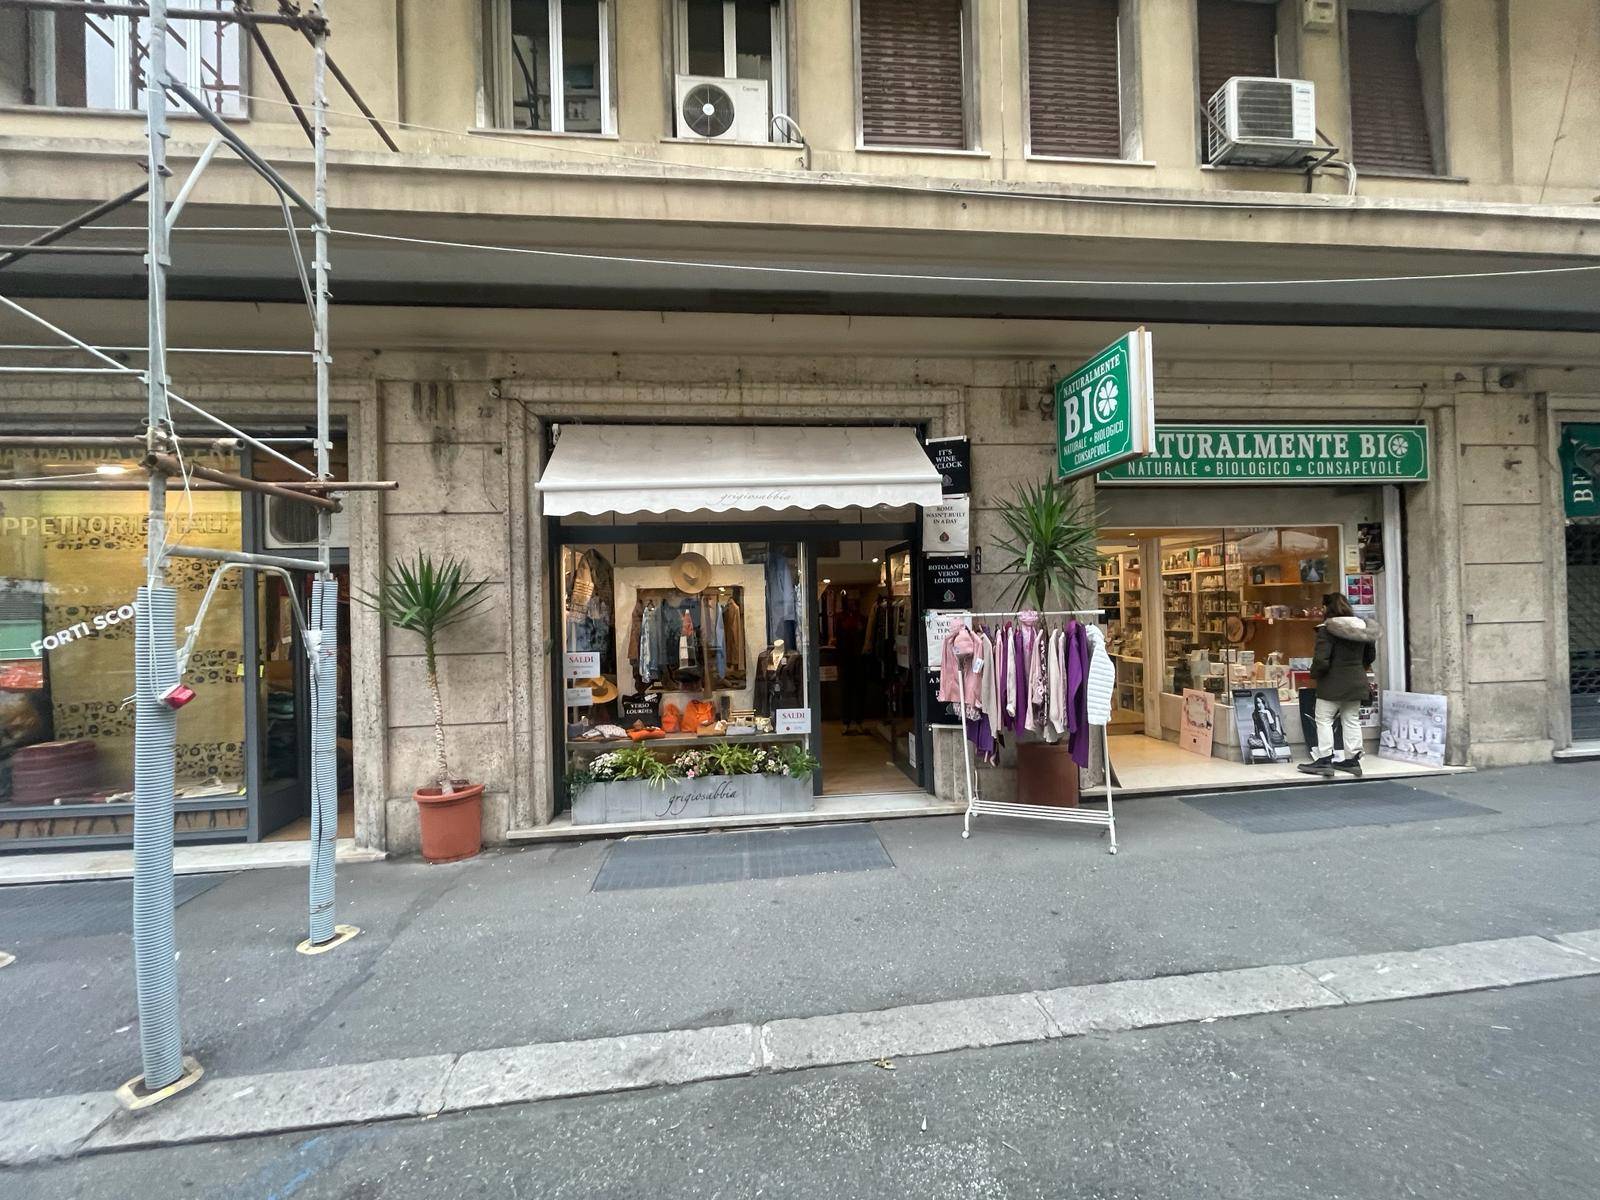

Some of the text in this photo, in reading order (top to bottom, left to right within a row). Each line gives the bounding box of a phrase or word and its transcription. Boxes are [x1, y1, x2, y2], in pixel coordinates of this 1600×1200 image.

[1063, 354, 1121, 399] NATURALMENTE
[1063, 374, 1120, 442] BIO
[1063, 420, 1124, 457] NATURALE BIOLOGICO
[1146, 432, 1409, 460] TURALMENTE BIO
[935, 455, 957, 463] WINE
[1074, 440, 1111, 465] CONSAPEVOLE
[1128, 460, 1402, 476] NATURALE BIOLOGICO CONSAPEVOLE
[87, 514, 230, 535] ORIETALI
[928, 563, 969, 571] ROTOLANDO
[30, 622, 90, 656] FORTI
[569, 656, 594, 664] SALDI
[655, 780, 737, 817] grigiosabbia
